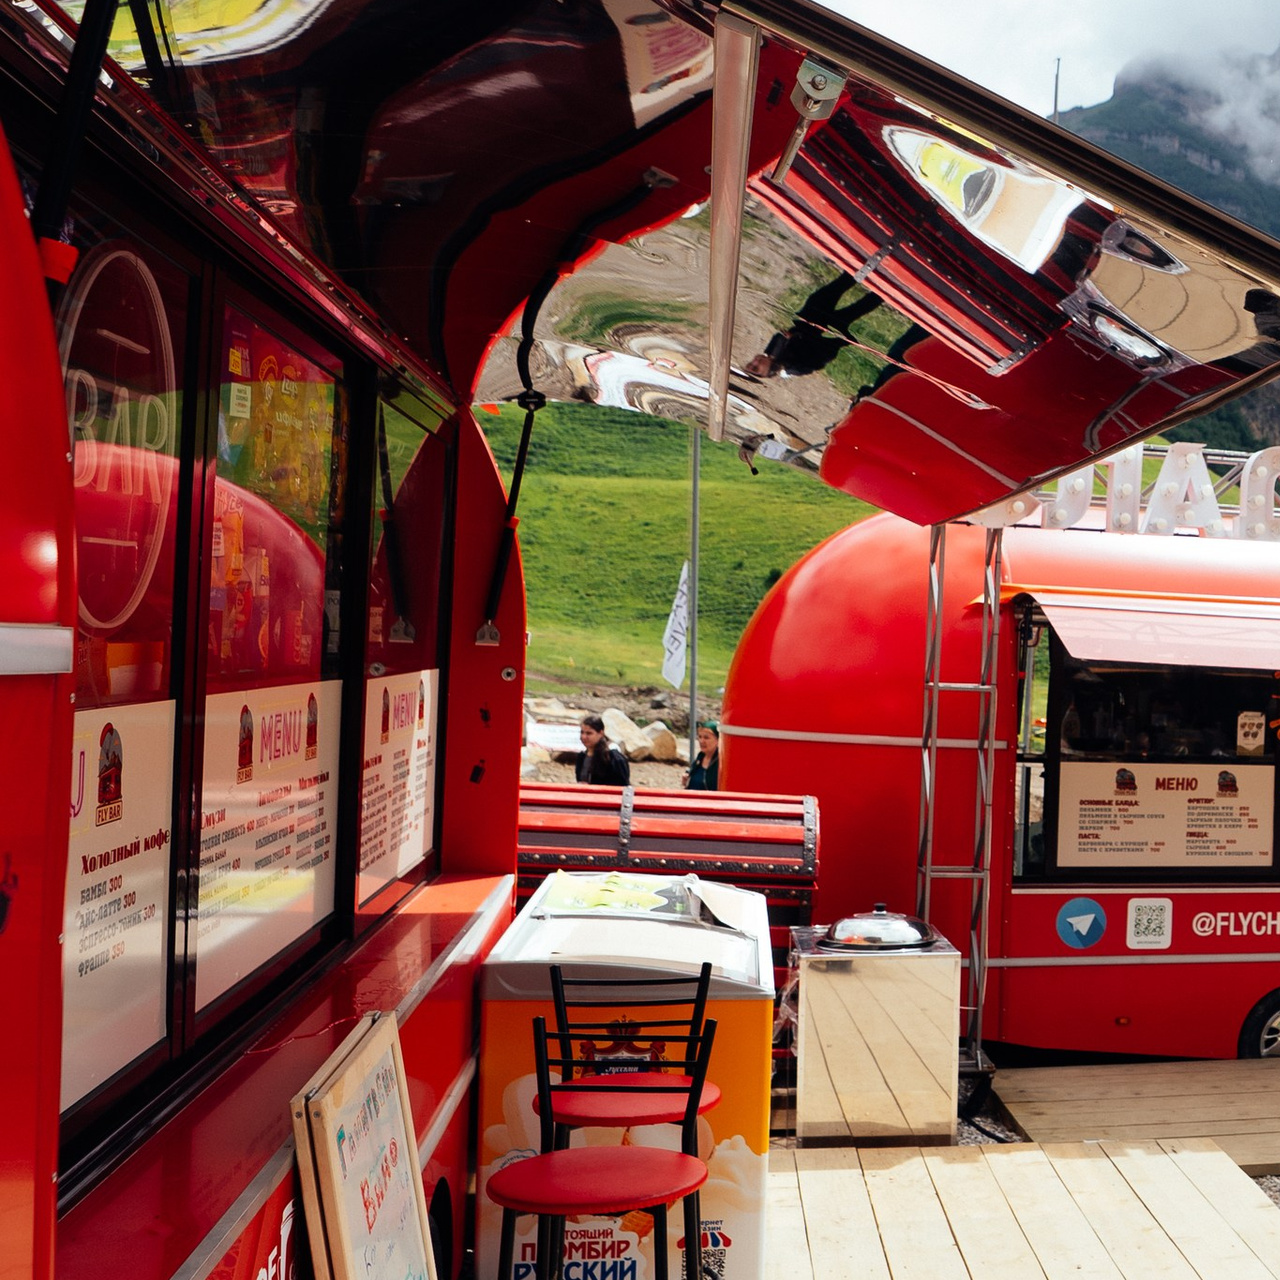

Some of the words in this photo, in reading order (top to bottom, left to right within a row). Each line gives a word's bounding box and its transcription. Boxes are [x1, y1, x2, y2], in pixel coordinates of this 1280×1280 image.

[393, 692, 417, 730] MENU
[260, 709, 302, 763] MENU
[1155, 777, 1199, 791] МЕНЮ
[98, 807, 110, 824] FLY
[110, 803, 123, 820] BAR
[81, 835, 143, 877] Холодный
[144, 827, 172, 851] кофе
[110, 874, 124, 893] 300
[124, 891, 138, 909] 300
[564, 1227, 614, 1240] ТОЯЩИЙ
[521, 1240, 631, 1261] ПМБИР
